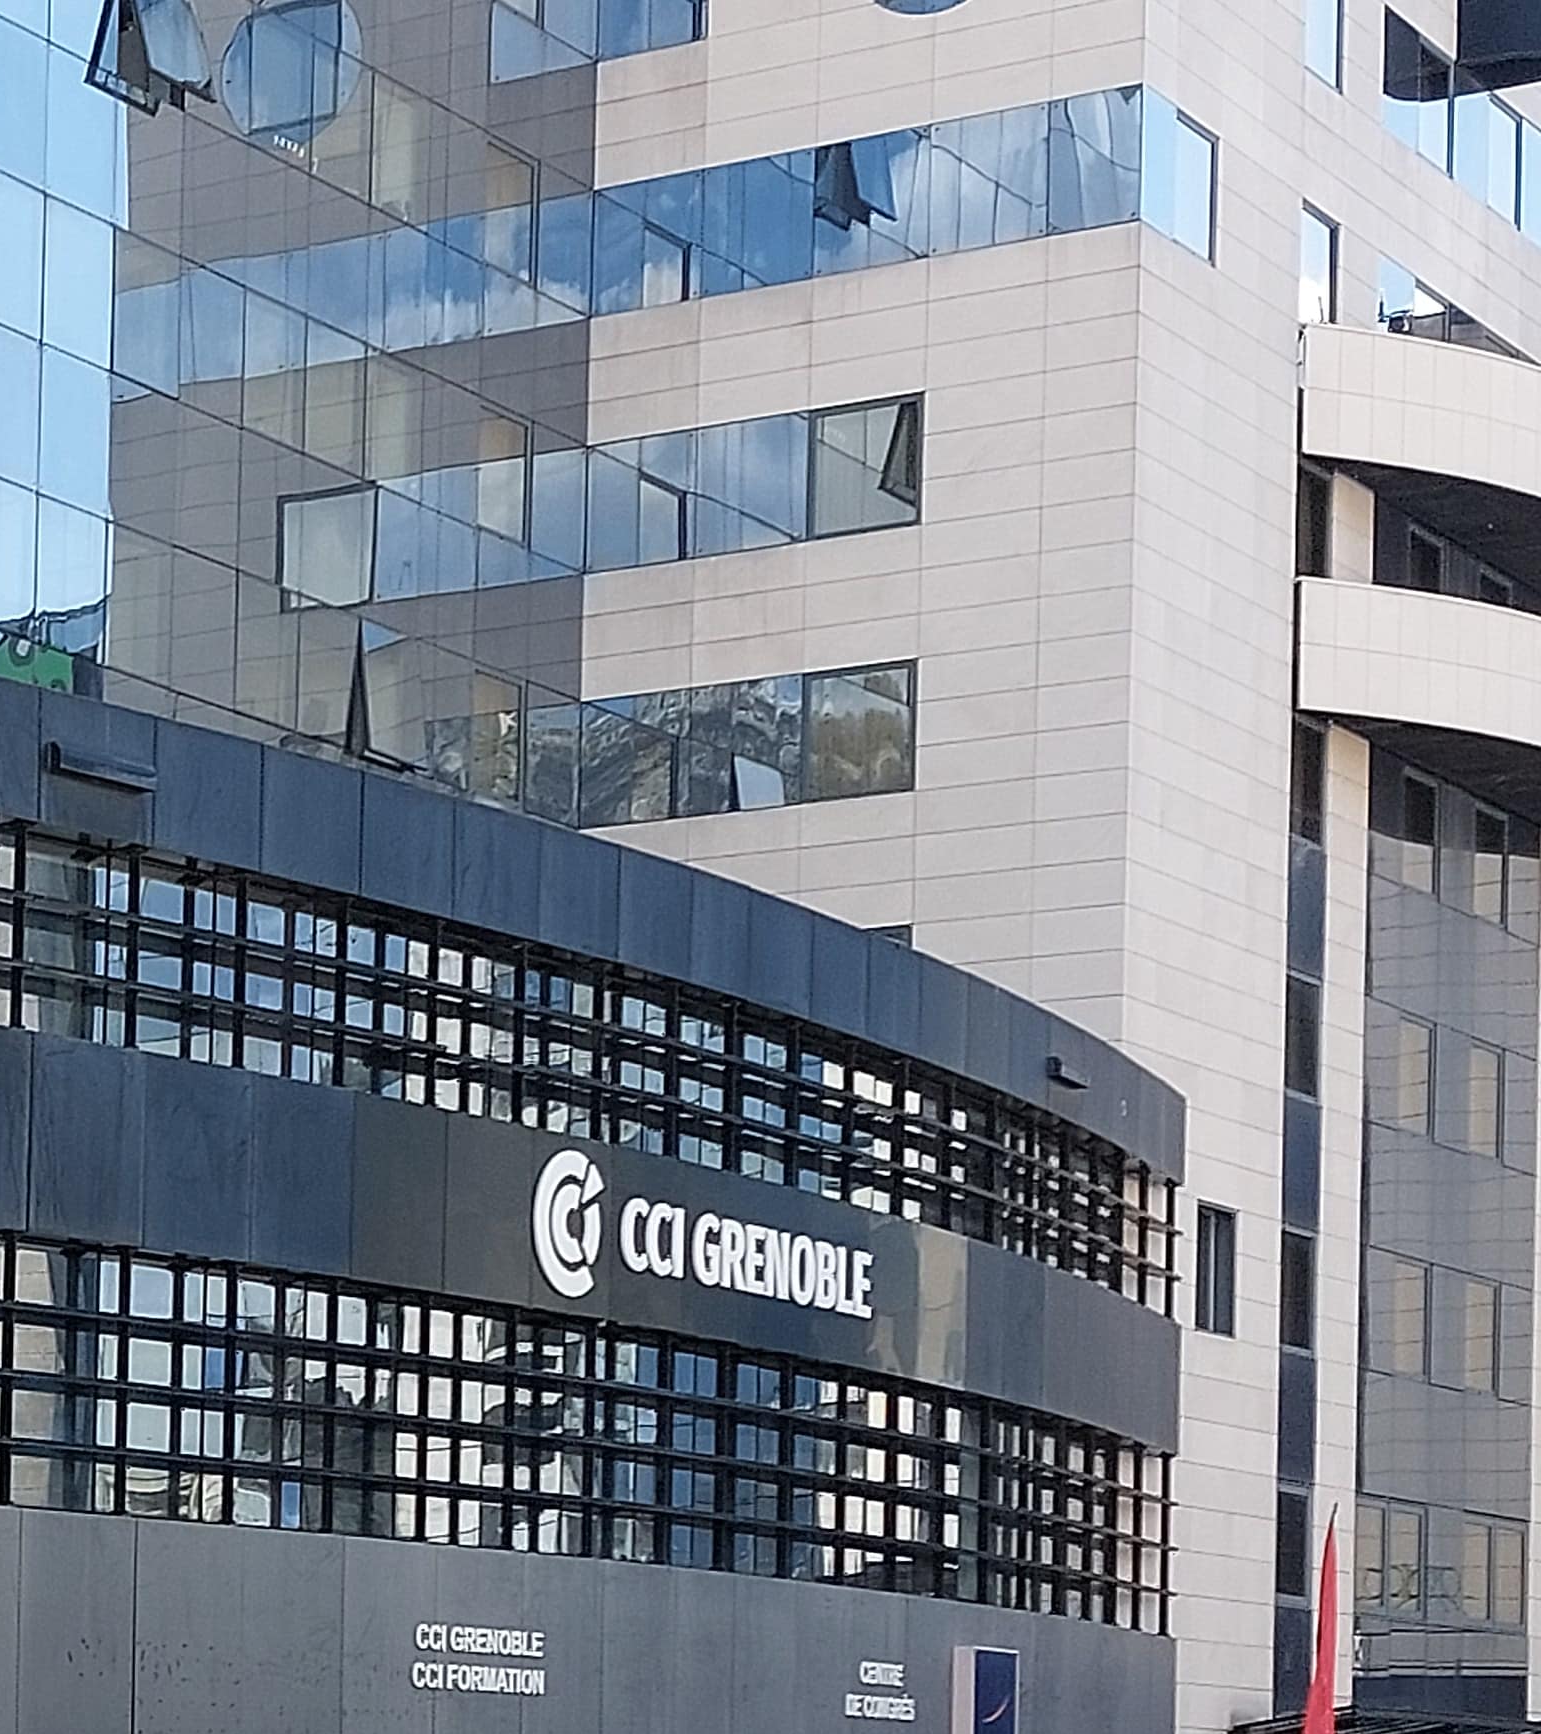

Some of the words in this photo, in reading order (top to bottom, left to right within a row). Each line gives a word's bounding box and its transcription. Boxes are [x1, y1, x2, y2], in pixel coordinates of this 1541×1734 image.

[621, 1197, 686, 1279] CCI
[692, 1211, 874, 1319] GRENOBLE
[416, 1623, 447, 1652] CCI
[450, 1626, 545, 1658] GRENOBLE
[412, 1661, 444, 1689] CCI
[446, 1664, 545, 1695] FORMATION
